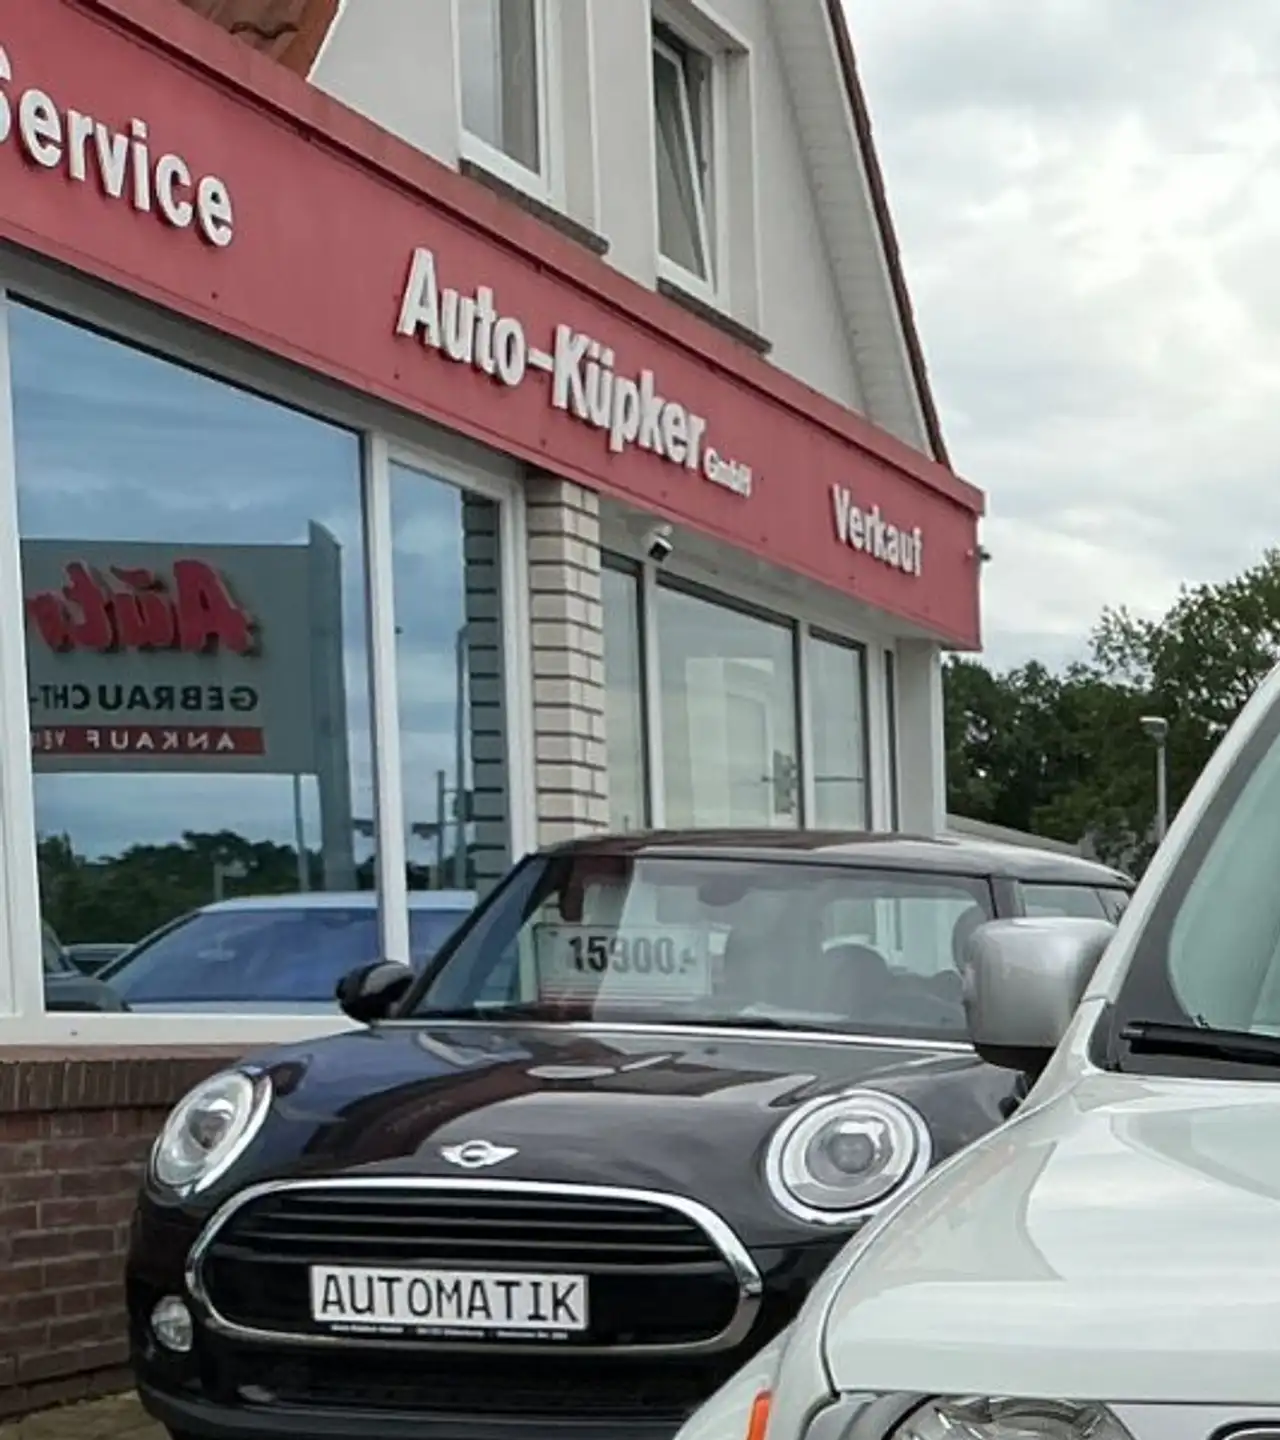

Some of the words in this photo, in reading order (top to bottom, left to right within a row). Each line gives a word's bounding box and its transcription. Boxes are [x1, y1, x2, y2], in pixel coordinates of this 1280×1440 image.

[0, 45, 233, 247] ervice
[395, 247, 706, 470] Auto-Küpker
[703, 448, 752, 498] GmbH
[832, 482, 922, 577] Verkauf
[320, 1273, 580, 1322] AUTOMATIK
